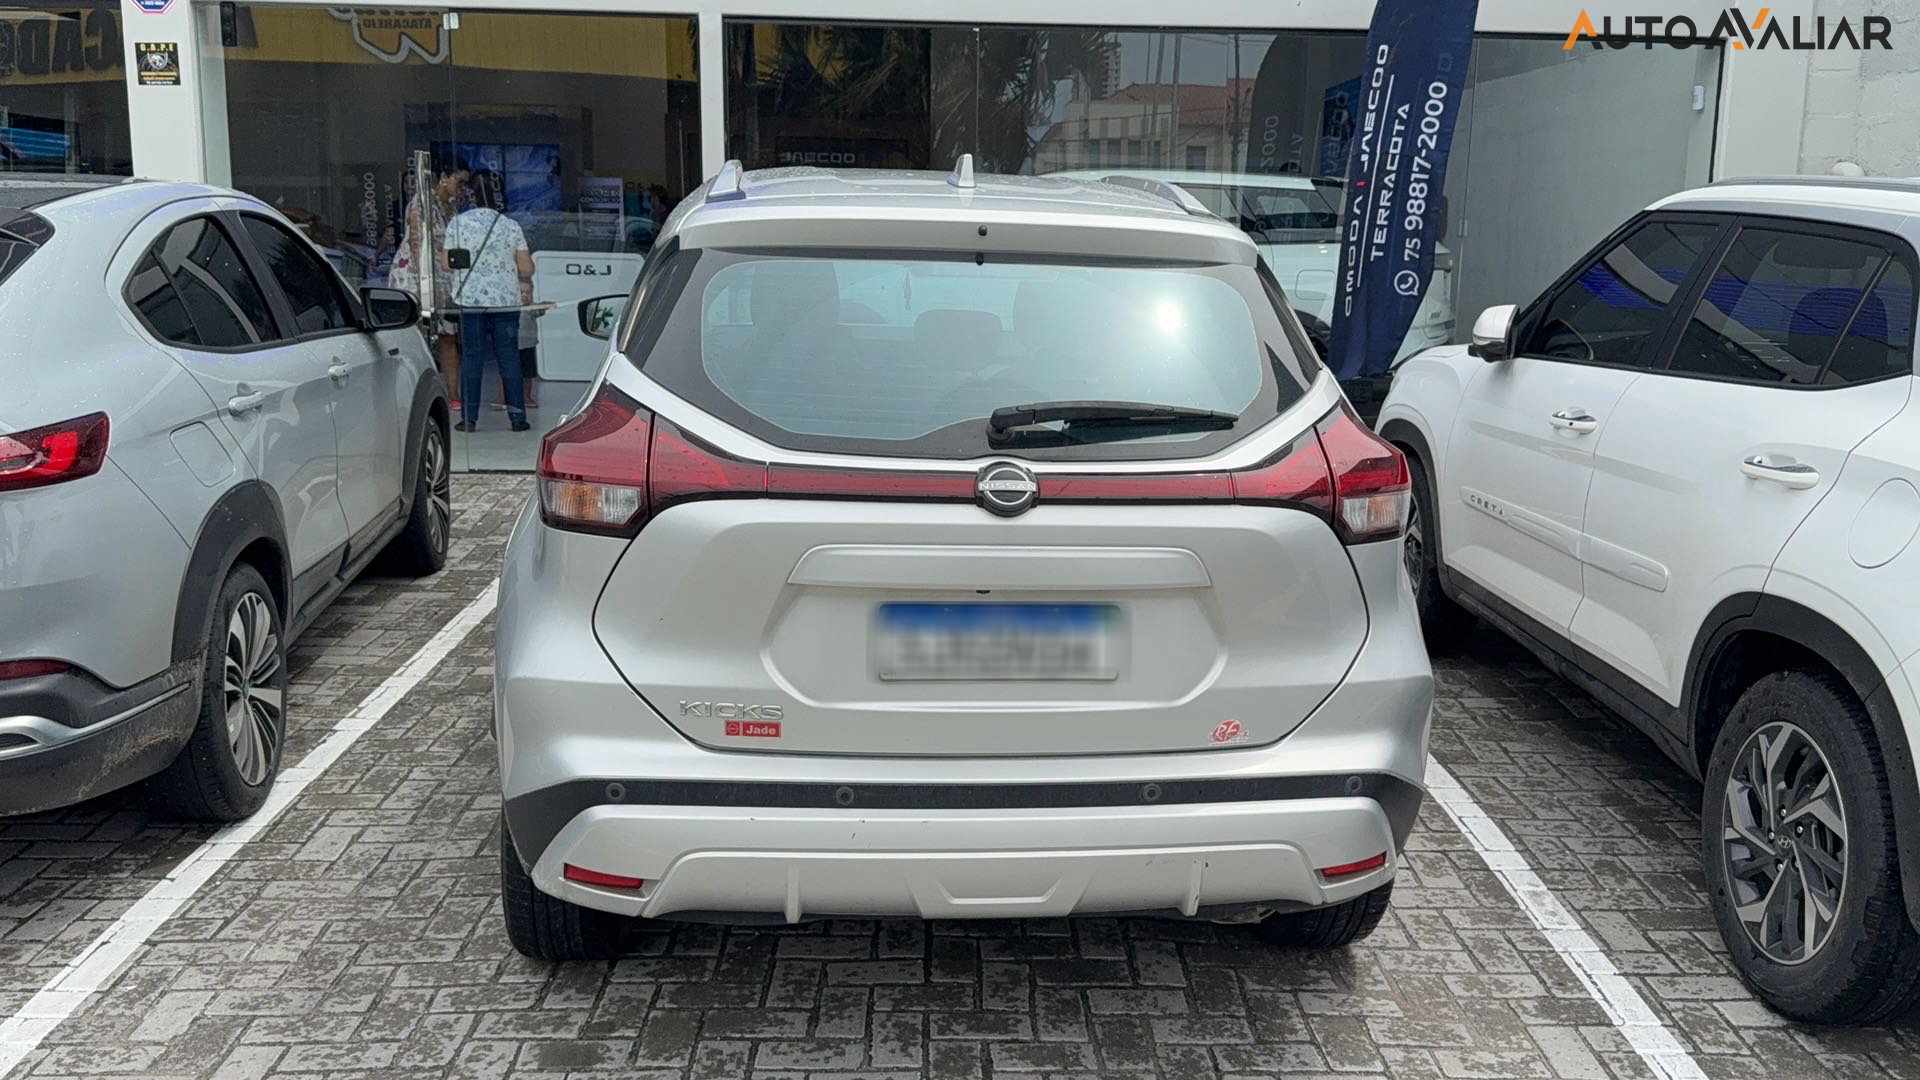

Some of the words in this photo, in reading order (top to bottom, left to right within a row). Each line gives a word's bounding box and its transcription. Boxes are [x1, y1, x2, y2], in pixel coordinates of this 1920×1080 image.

[778, 151, 856, 164] JAECOO
[1404, 81, 1448, 231] 98817-2000
[1345, 194, 1364, 318] OMODA
[1360, 44, 1389, 173] JAECOO
[1370, 103, 1410, 262] TERRACOTA
[1404, 237, 1422, 262] 75
[565, 263, 612, 276] O&J
[980, 481, 1036, 492] NISSAN
[1470, 494, 1504, 516] CRETA
[679, 700, 784, 720] KICKS
[745, 725, 777, 736] Jade
